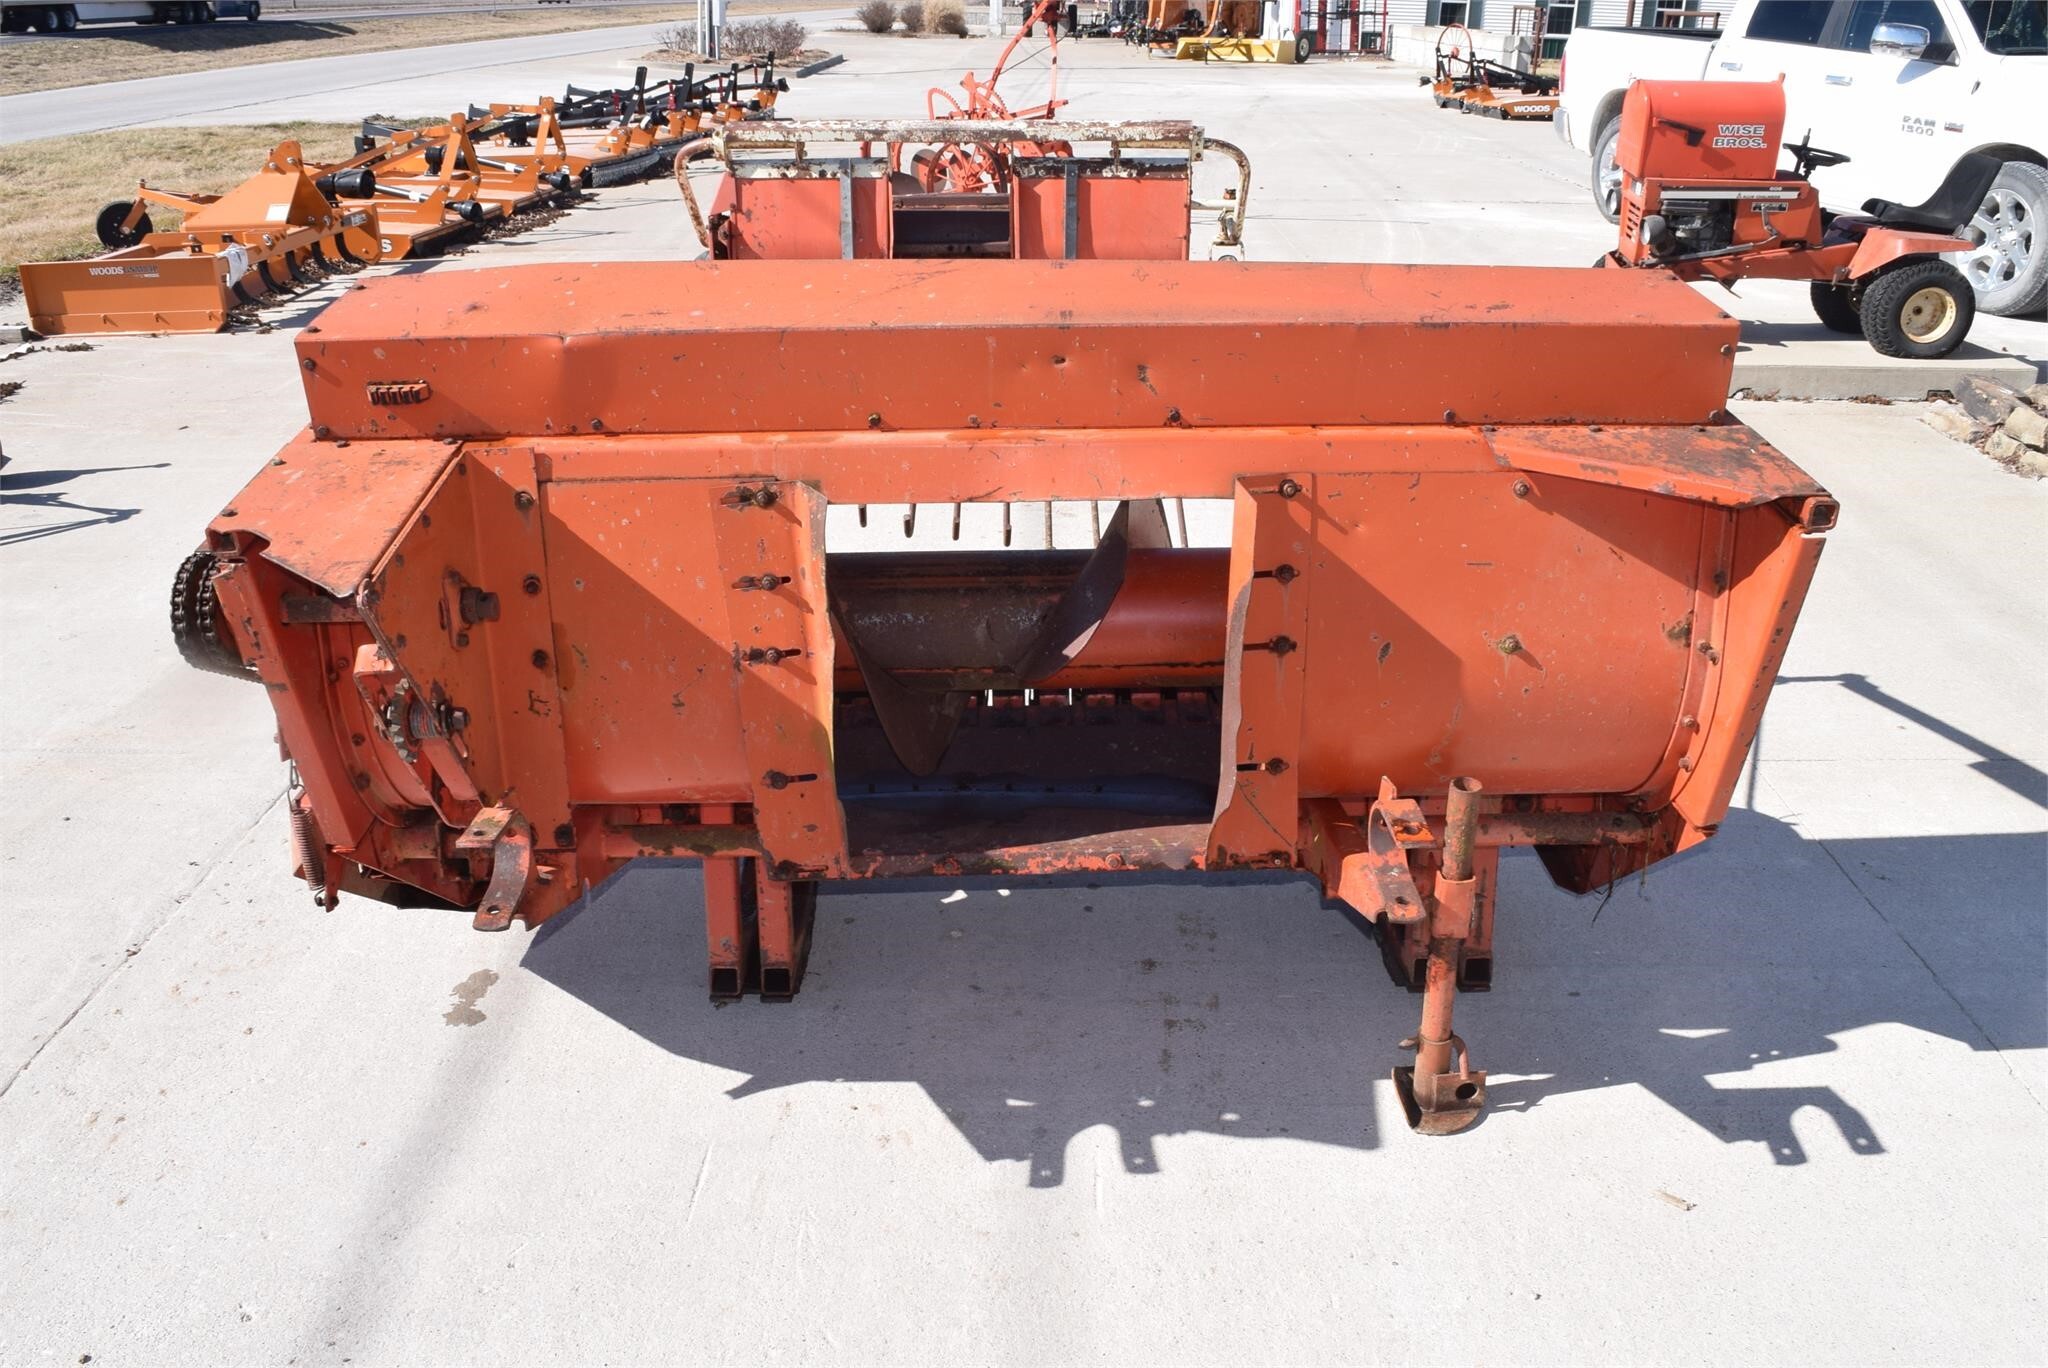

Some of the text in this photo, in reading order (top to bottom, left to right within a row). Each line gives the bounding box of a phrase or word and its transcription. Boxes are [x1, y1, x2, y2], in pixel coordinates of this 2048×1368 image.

[1903, 115, 1936, 127] RAM
[1718, 124, 1765, 136] WISE
[1902, 124, 1934, 136] 1500
[1712, 136, 1767, 148] BROS.
[89, 266, 124, 276] WOODS
